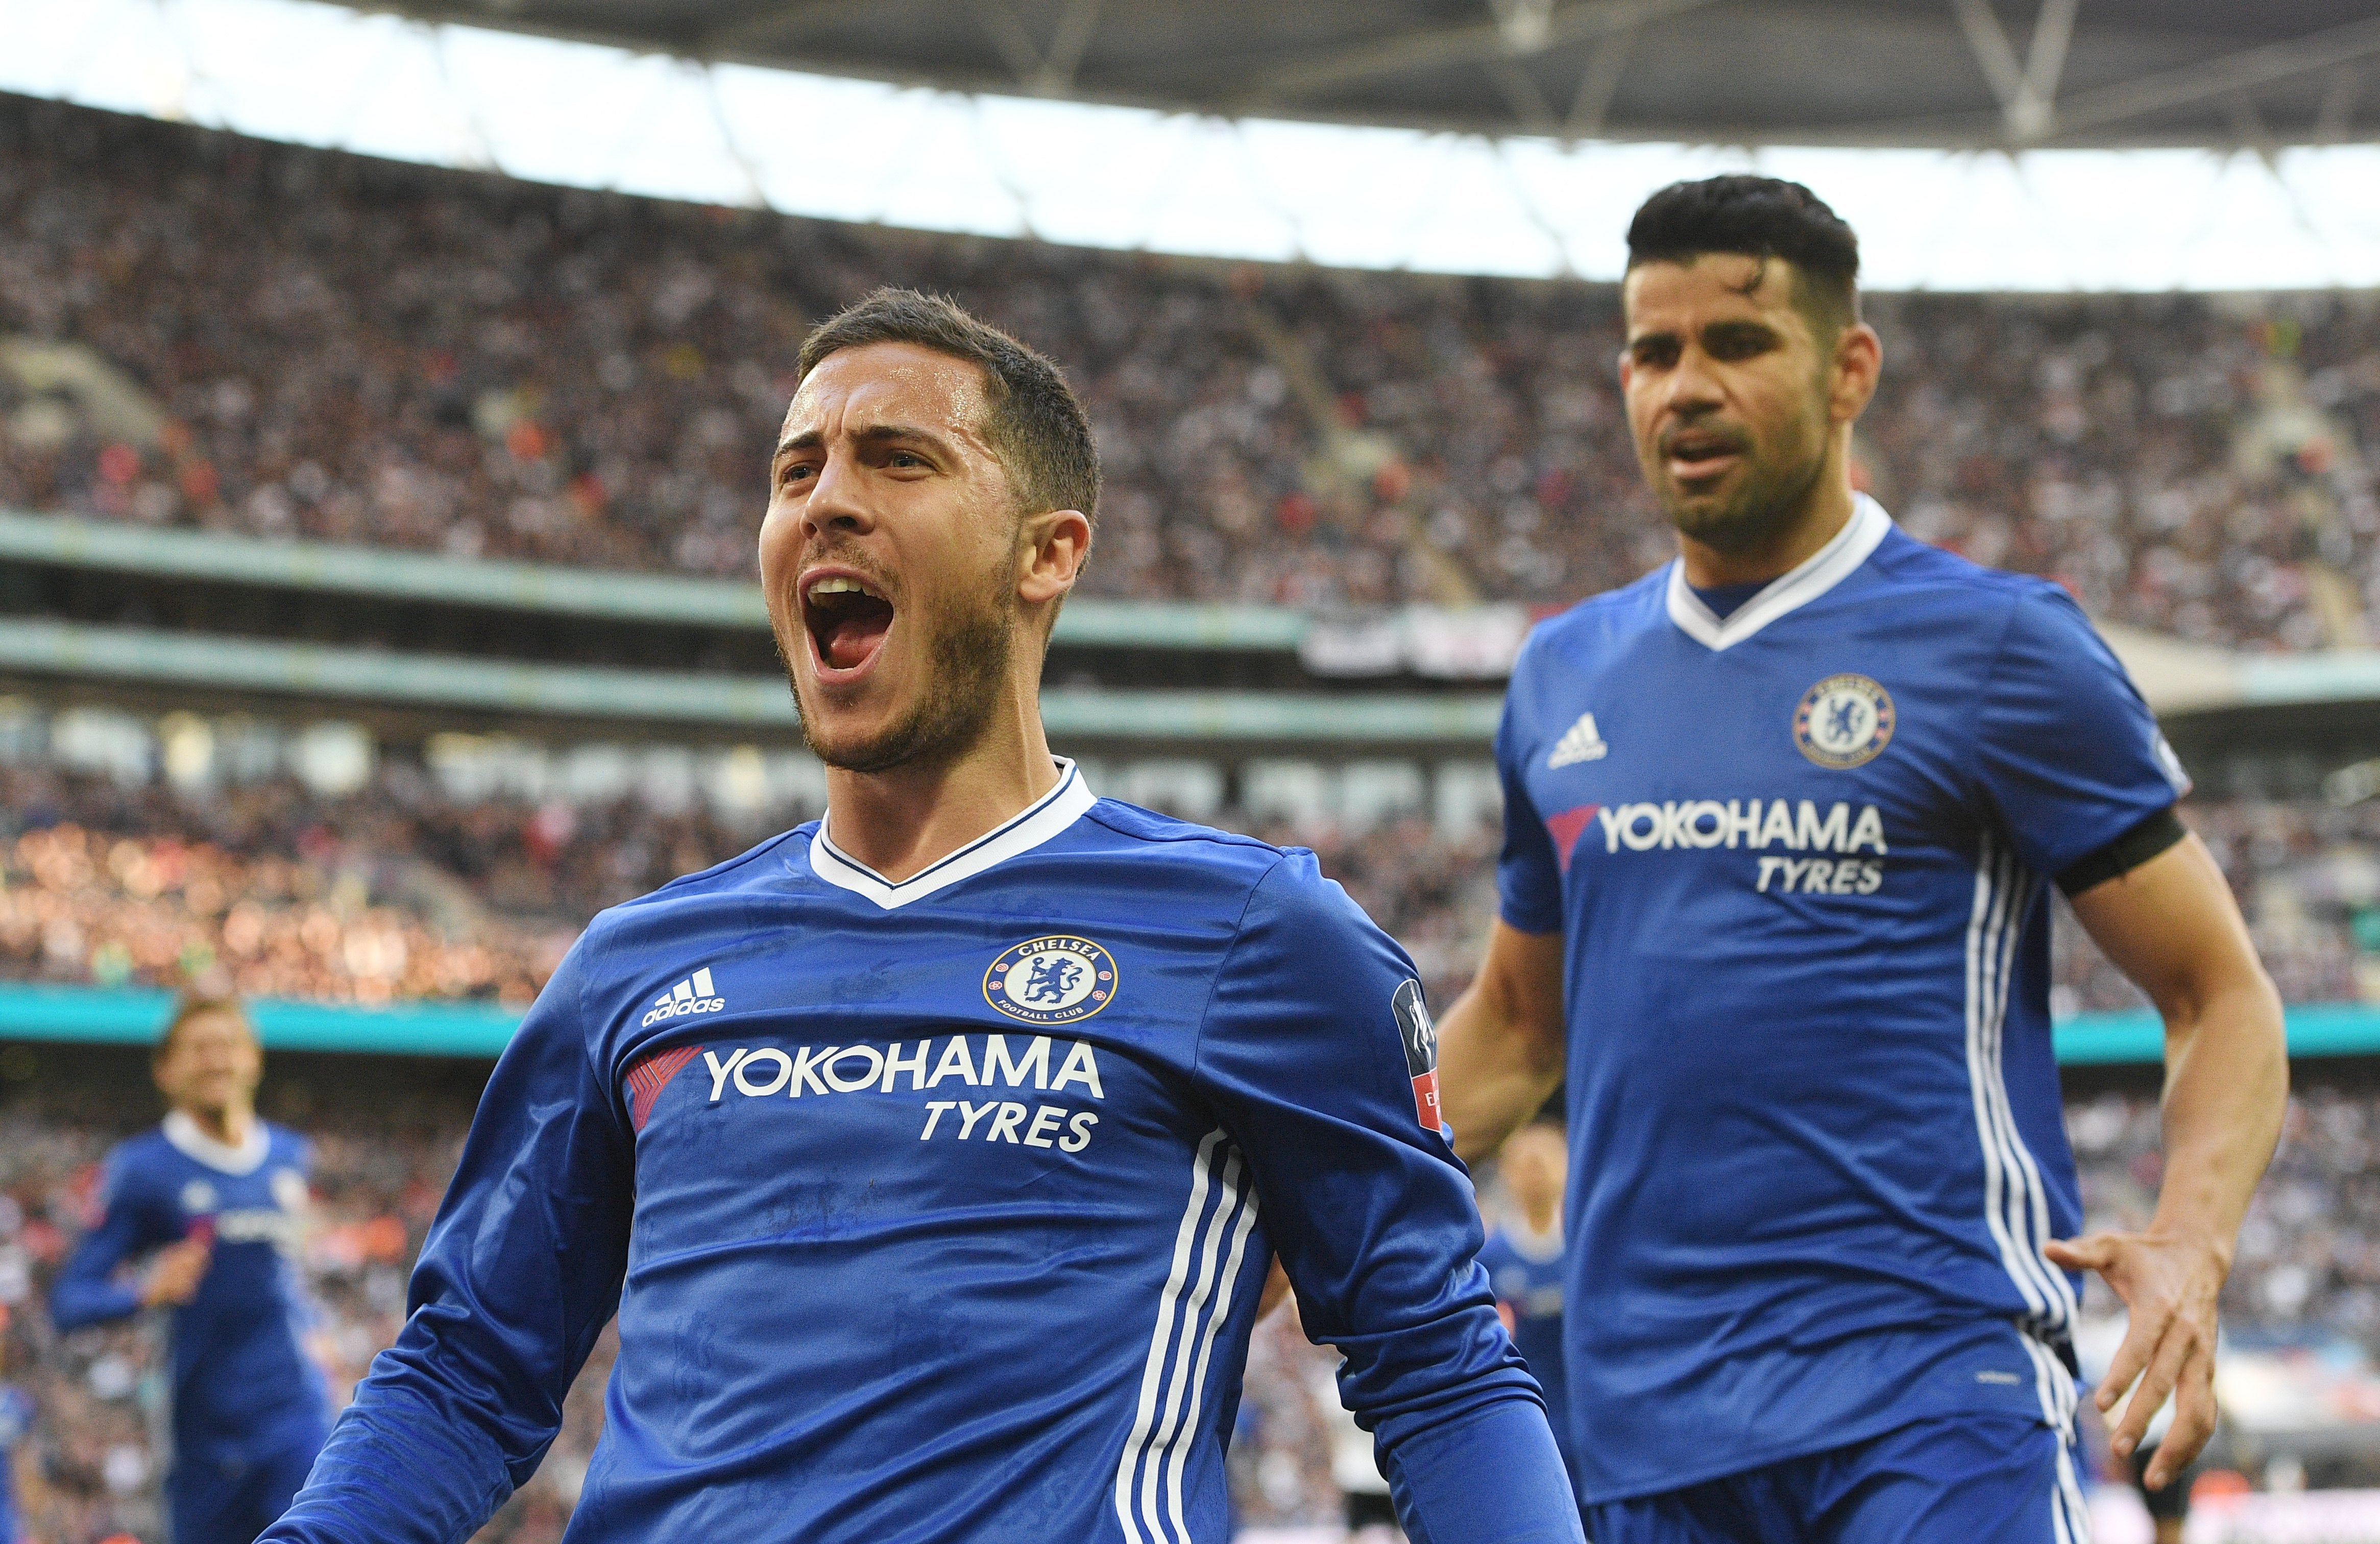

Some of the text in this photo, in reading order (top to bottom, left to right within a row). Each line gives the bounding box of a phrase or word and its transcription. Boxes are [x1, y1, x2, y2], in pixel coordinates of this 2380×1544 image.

[1597, 798, 1888, 855] YOKOHAMA
[1756, 855, 1886, 895] TYRES
[1017, 938, 1102, 961] CHELSEA
[641, 996, 726, 1028] adidas
[997, 999, 1084, 1020] FOOTBALL CLUB
[702, 1033, 1105, 1102] YOKOHAMA
[920, 1100, 1099, 1153] TYRES
